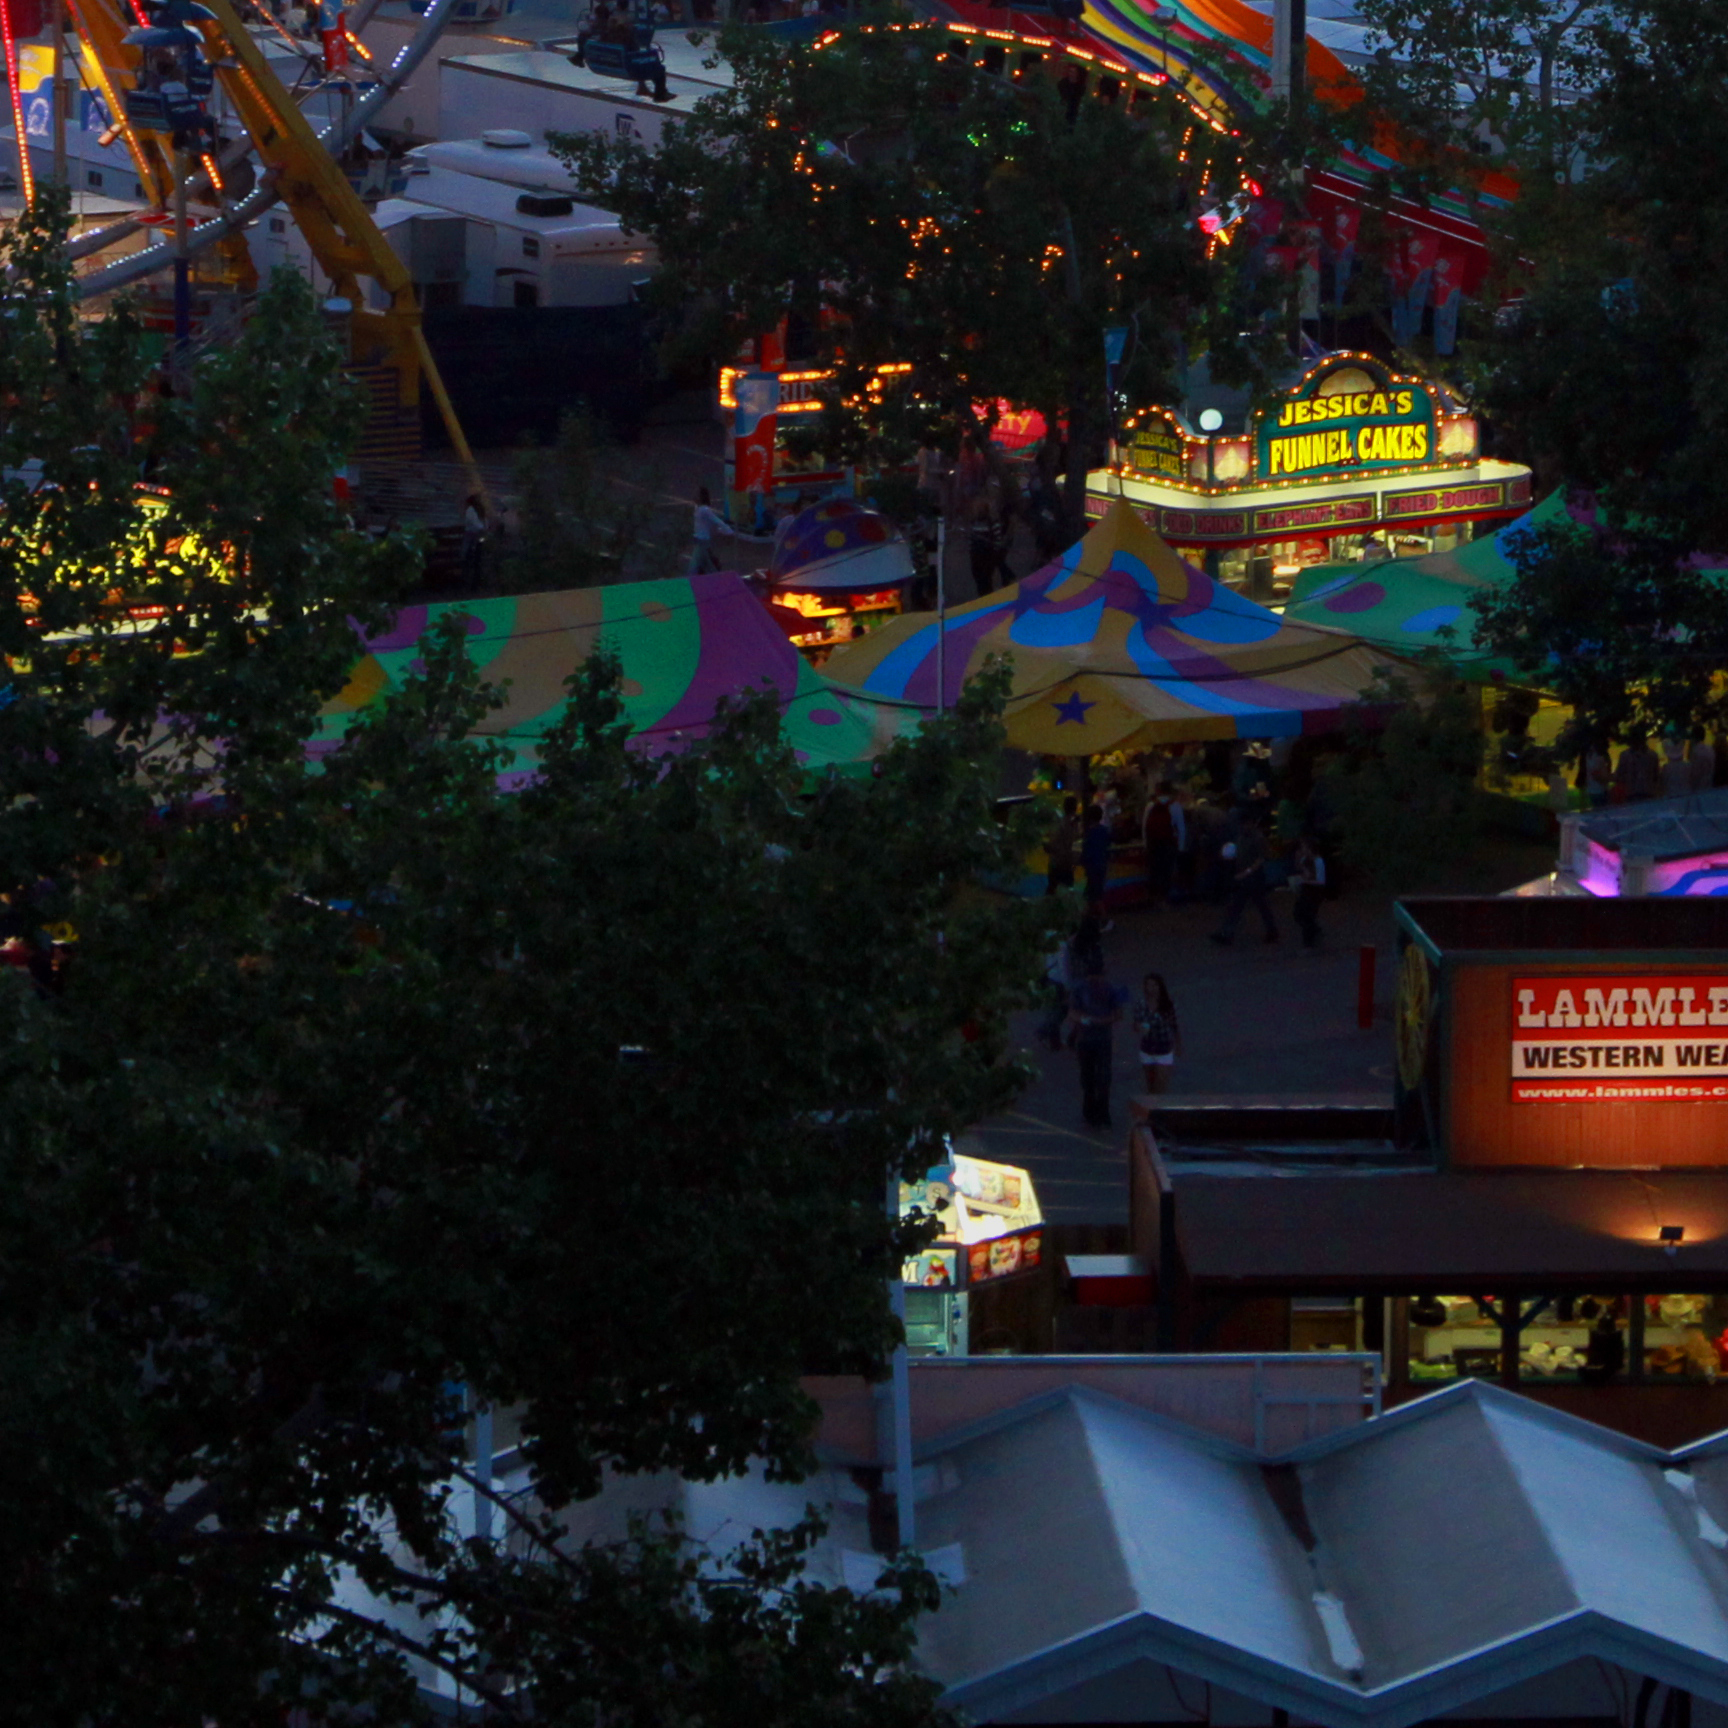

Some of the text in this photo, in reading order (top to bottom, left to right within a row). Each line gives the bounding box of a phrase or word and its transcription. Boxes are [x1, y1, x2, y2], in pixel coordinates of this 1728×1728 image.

[1279, 390, 1414, 427] JESSICA'S
[1270, 423, 1428, 476] FUNNEL CAKES
[1388, 495, 1438, 515] FRIED
[1442, 485, 1501, 509] DOUGH
[1523, 1045, 1664, 1069] WESTERN
